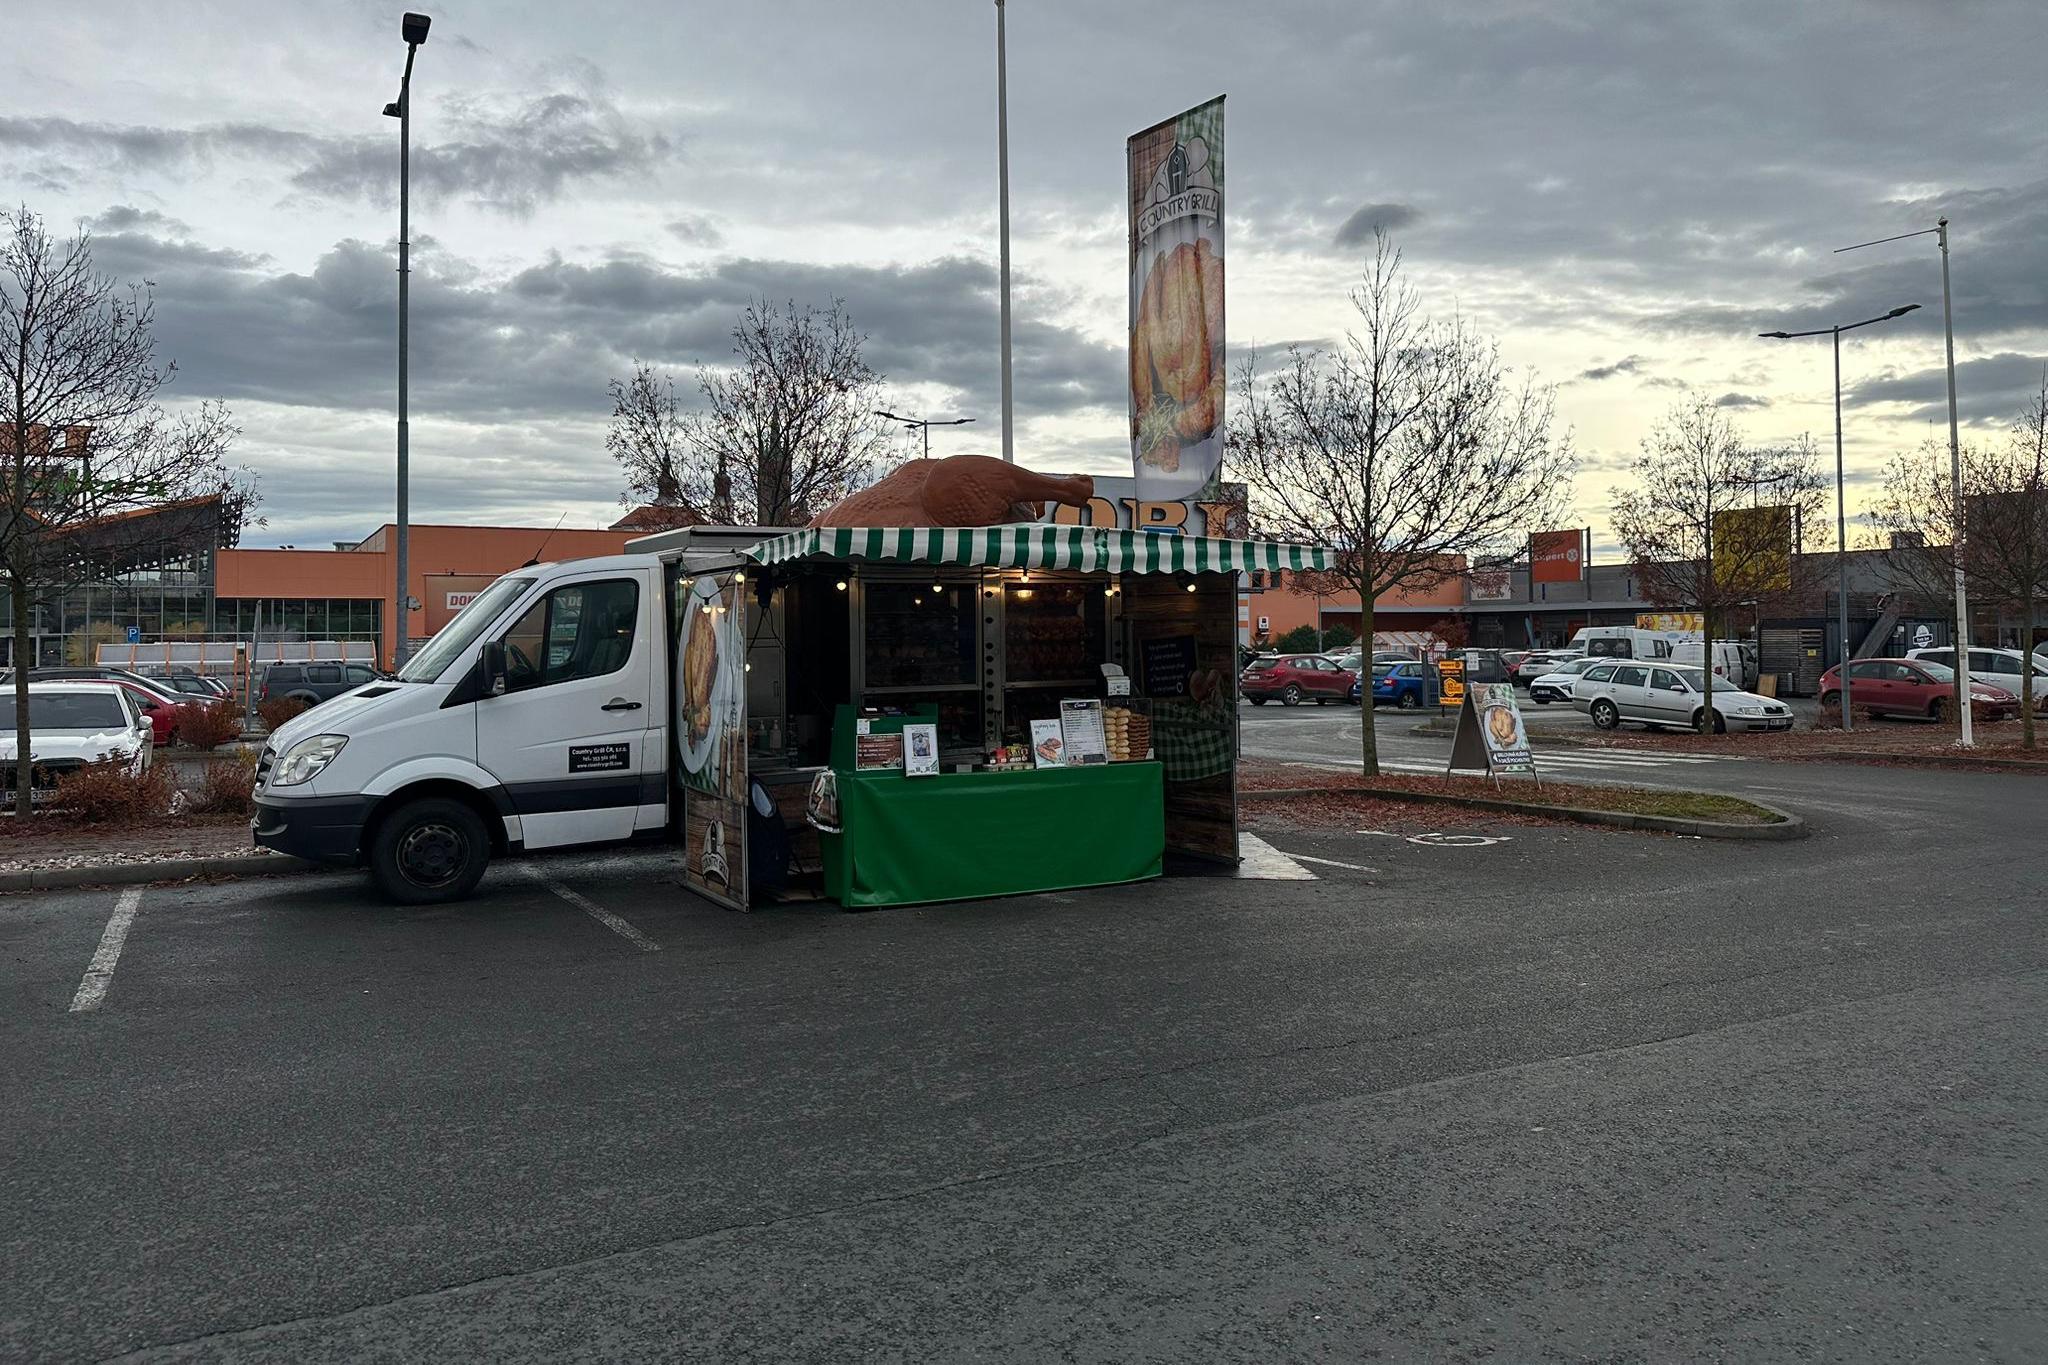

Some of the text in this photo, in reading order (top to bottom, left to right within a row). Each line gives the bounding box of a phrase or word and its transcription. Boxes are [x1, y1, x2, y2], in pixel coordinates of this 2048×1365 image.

[1139, 193, 1217, 233] COUNTRY GRILL
[129, 628, 138, 638] P
